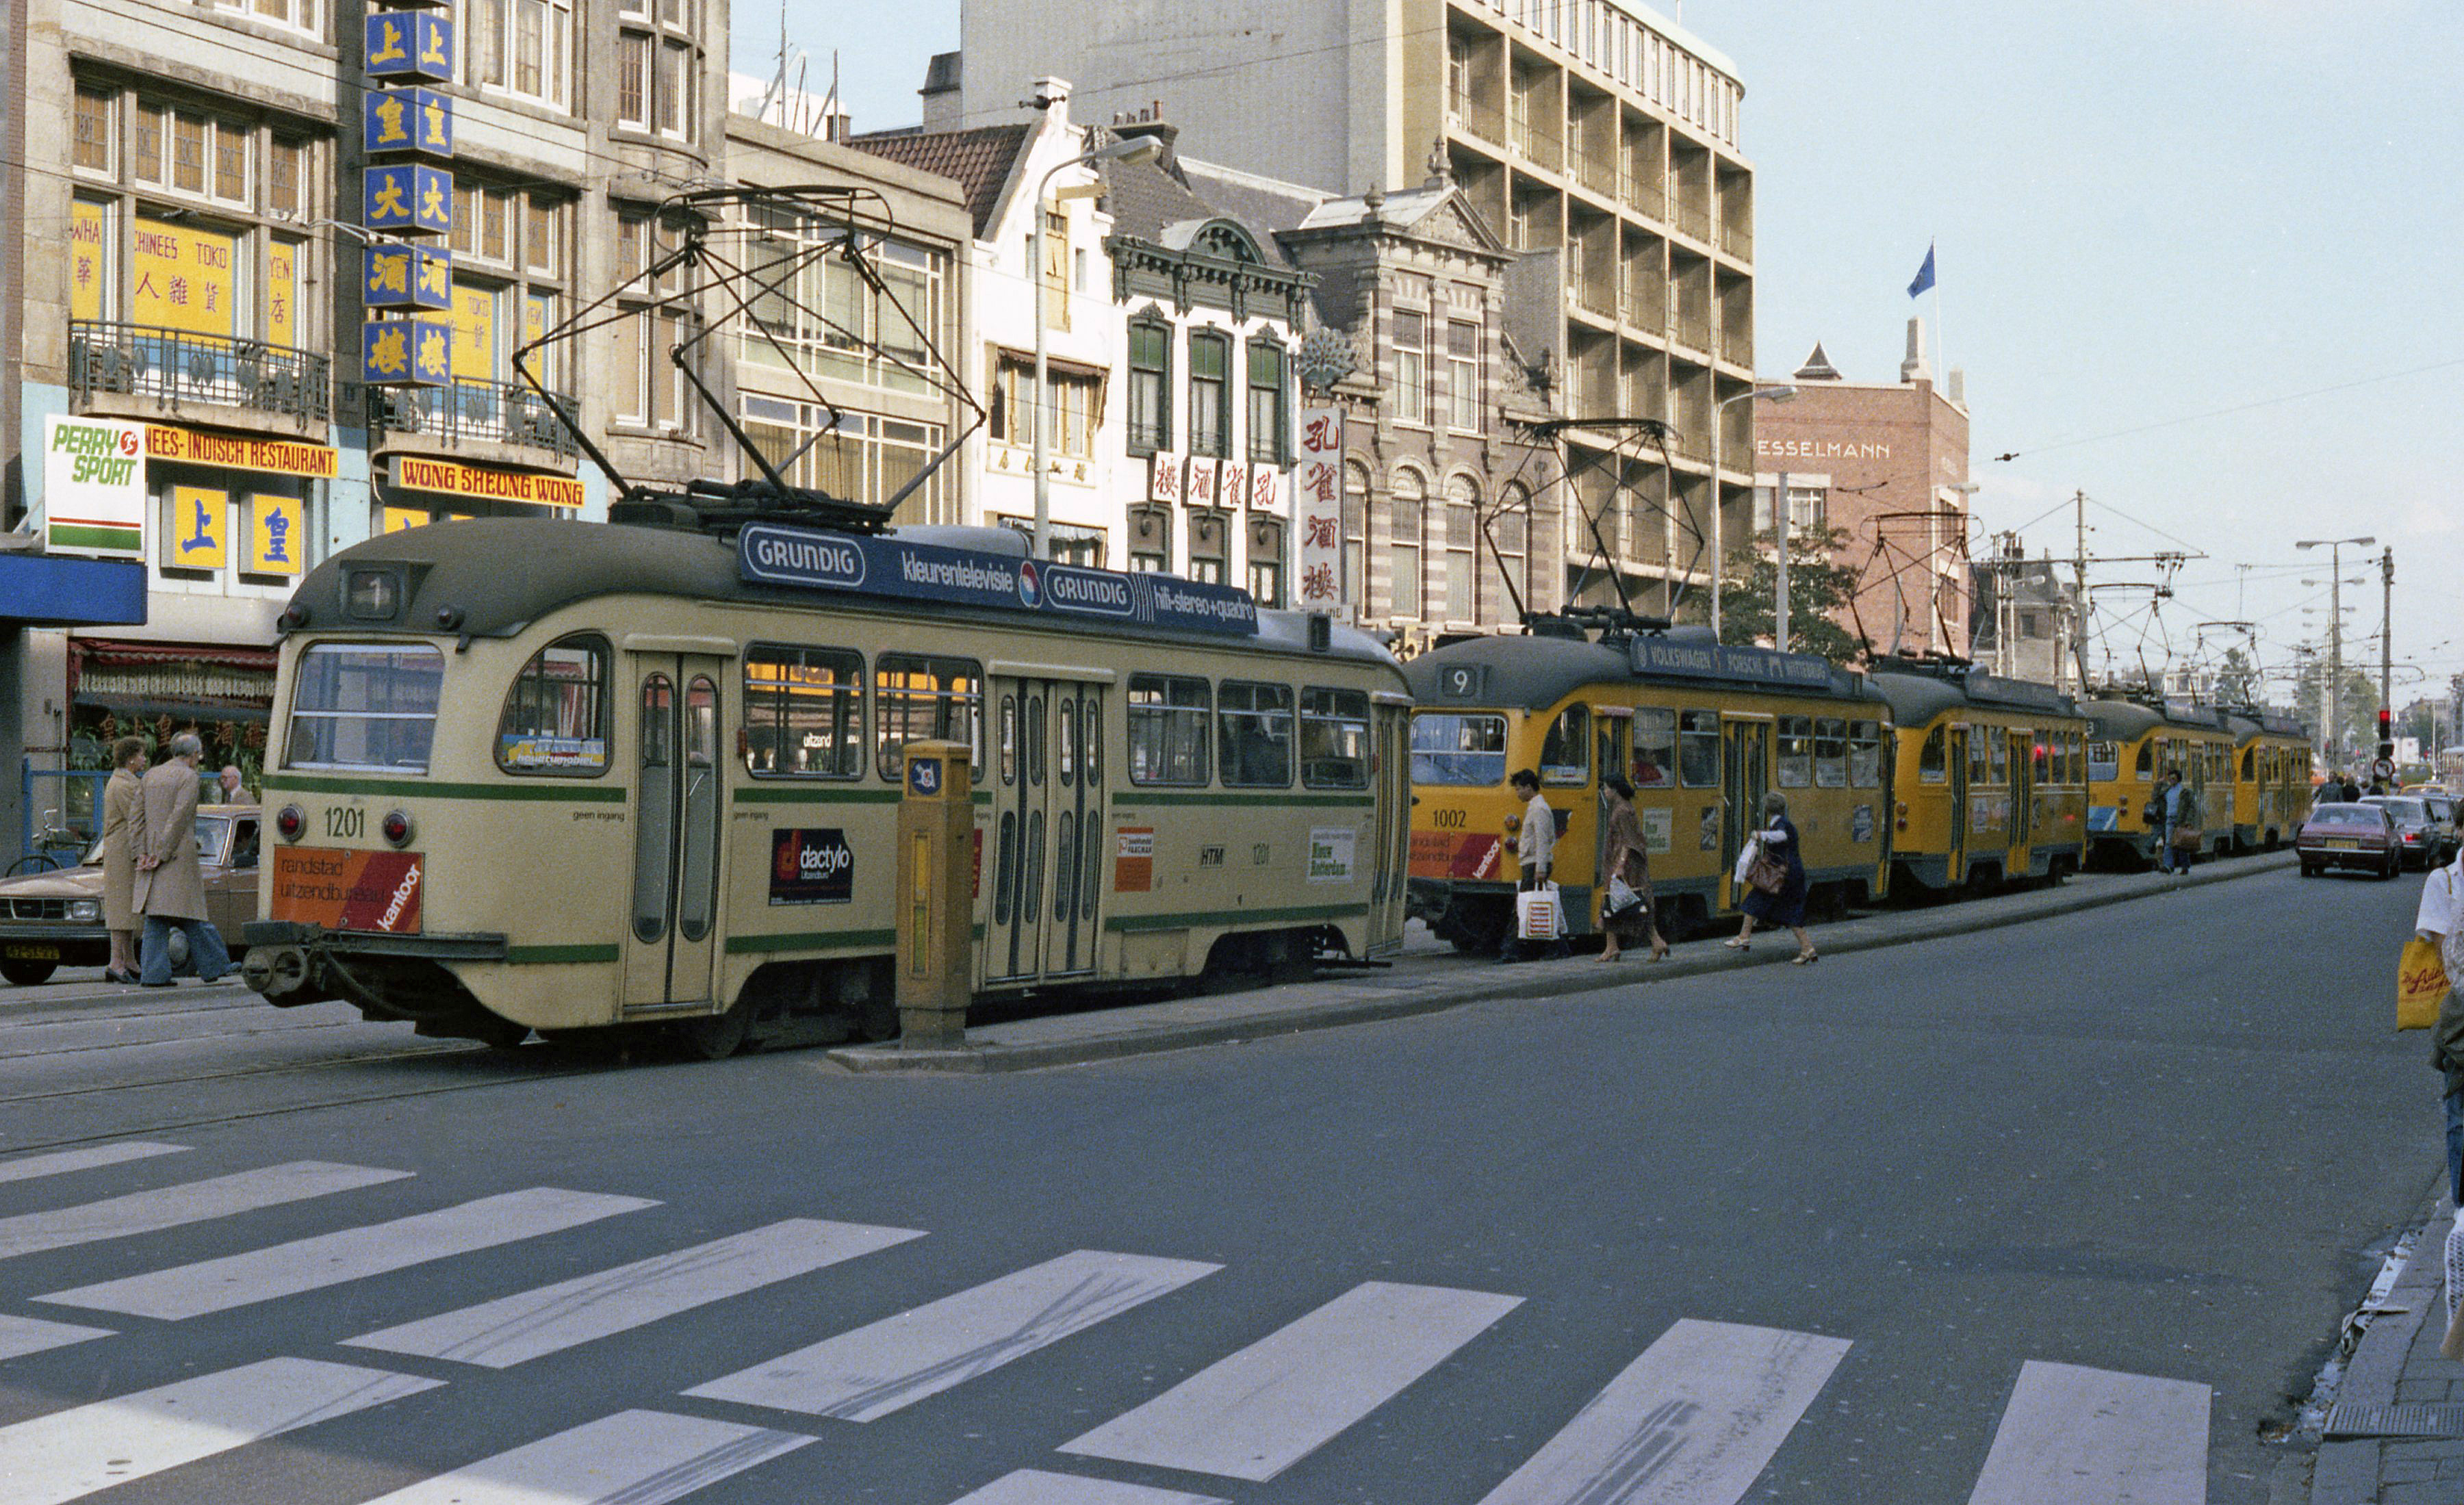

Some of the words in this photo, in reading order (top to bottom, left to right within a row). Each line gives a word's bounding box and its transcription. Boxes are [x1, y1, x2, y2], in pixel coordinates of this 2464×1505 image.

[135, 231, 178, 259] HINEES
[196, 243, 227, 269] TOKO
[52, 424, 119, 456] PERRY
[188, 429, 244, 464] INDISCH
[251, 441, 334, 474] RESTAURANT
[1757, 440, 1890, 459] ESSELMANN
[72, 456, 137, 486] SPORT
[403, 461, 455, 489] WONG
[461, 469, 530, 498] SHEUNG
[536, 478, 582, 505] WONG
[181, 499, 217, 553] 上
[264, 506, 290, 563] 皇
[758, 540, 854, 575] GRUNDIG
[902, 551, 1014, 593] kleurentelevisie
[1053, 576, 1127, 605] GRUNDIG
[370, 577, 381, 610] 1
[1650, 646, 1711, 669] VOLKSWAGEN
[1453, 670, 1469, 693] 9
[325, 806, 364, 838] 1201
[573, 812, 595, 821] geen
[597, 811, 625, 822] ingang
[1433, 810, 1467, 827] 1002
[281, 856, 344, 877] randstad
[800, 843, 849, 873] dactylo
[1201, 847, 1224, 865] HTM
[1472, 838, 1500, 879] kantoor
[280, 882, 385, 903] uitzendbureau
[377, 863, 421, 931] kantoor
